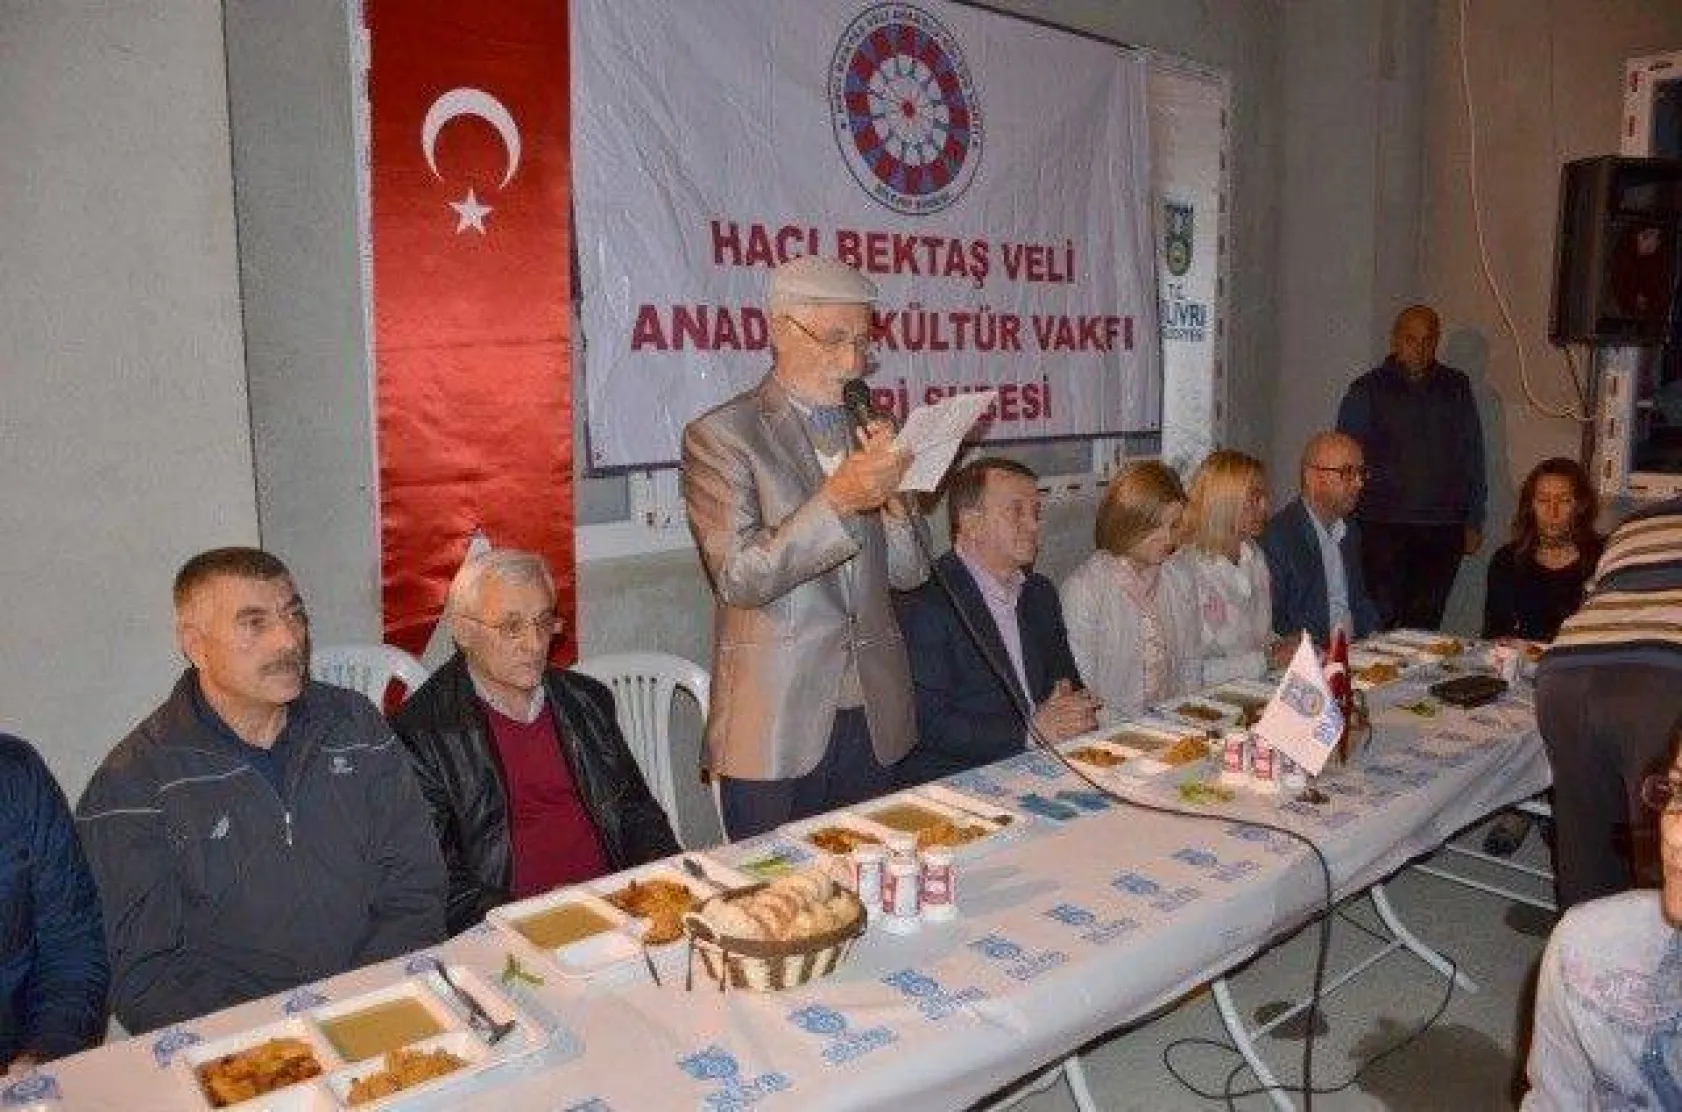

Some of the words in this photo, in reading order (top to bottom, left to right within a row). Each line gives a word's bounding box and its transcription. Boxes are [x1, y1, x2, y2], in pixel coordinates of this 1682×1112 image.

[710, 220, 819, 269] HACI
[835, 228, 990, 290] BEKTAŞ
[1000, 238, 1077, 285] VELİ
[630, 303, 770, 351] ANAD
[868, 301, 1022, 352] KÜLTÜR
[1030, 313, 1135, 352] VAKFI
